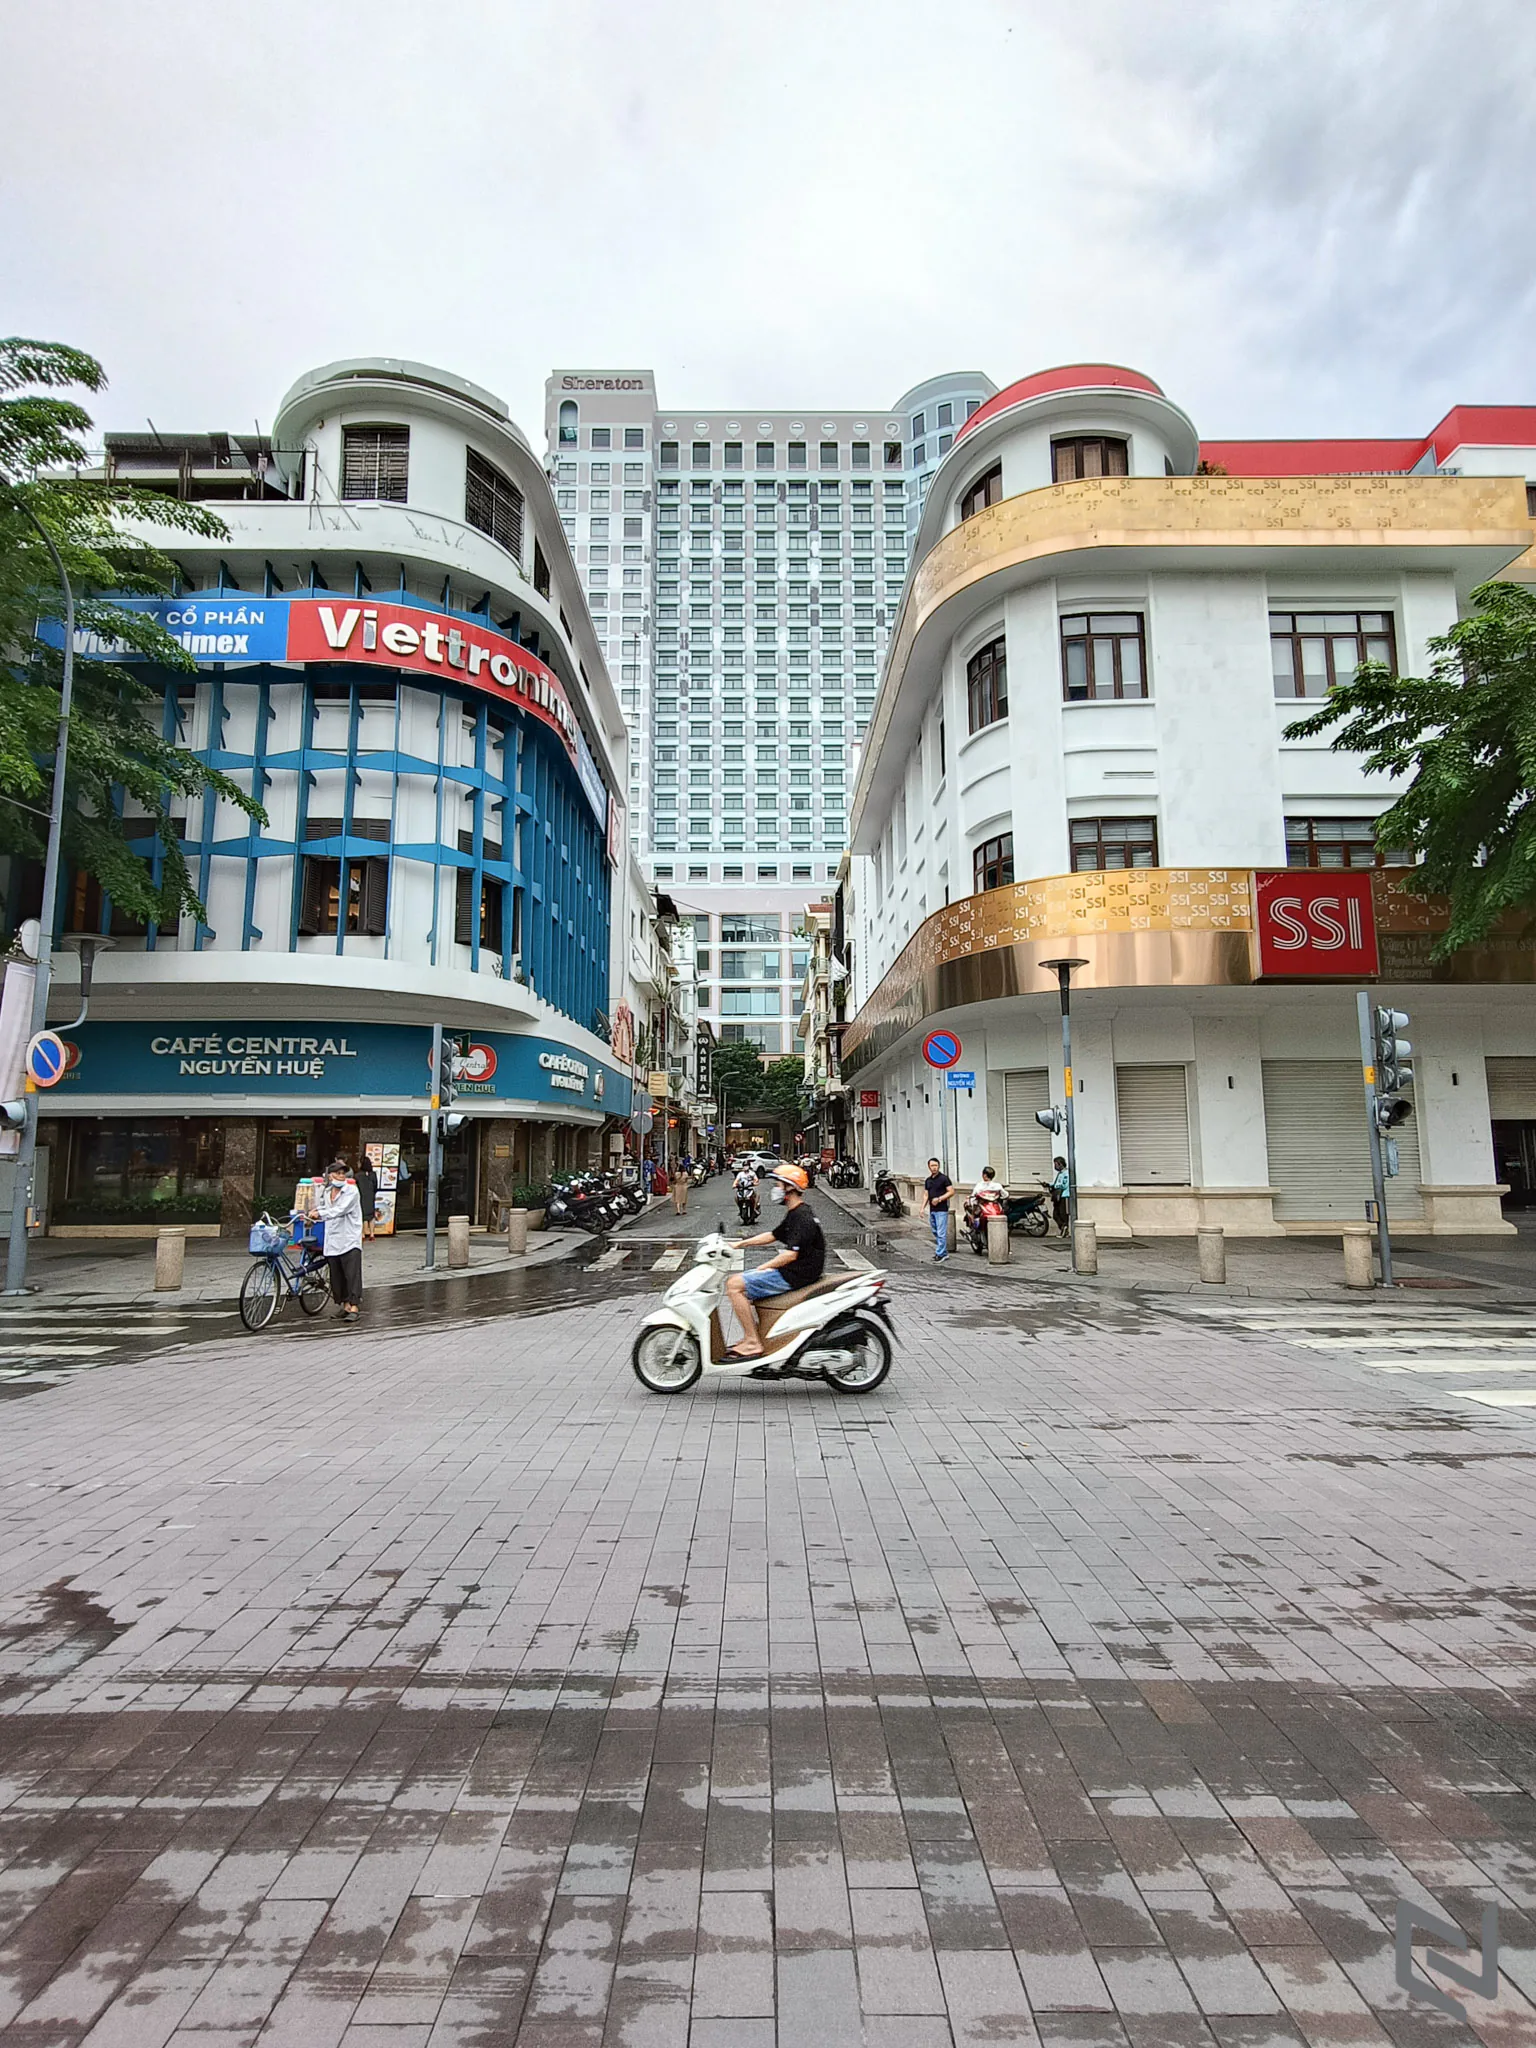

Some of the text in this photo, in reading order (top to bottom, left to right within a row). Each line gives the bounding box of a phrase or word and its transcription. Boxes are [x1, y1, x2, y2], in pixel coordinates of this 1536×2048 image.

[166, 604, 198, 625] CỔ
[204, 606, 264, 625] PHẦN
[1169, 871, 1189, 883] SSI
[1208, 871, 1227, 883] SSI
[1189, 882, 1208, 894] SSI
[1230, 882, 1249, 894] SSI
[1170, 894, 1190, 906] SSI
[1209, 894, 1229, 906] SSI
[1191, 905, 1210, 917] SSI
[1231, 905, 1251, 916] SSI
[1130, 916, 1150, 929] SSI
[1270, 897, 1363, 950] SSI
[1013, 928, 1030, 941] SSI
[983, 934, 997, 948] SSI
[150, 1033, 358, 1056] CAFÉ CENTRAL
[179, 1055, 325, 1079] NGUYỄN HUỆ
[474, 1083, 496, 1095] HUE
[861, 1093, 877, 1104] SSI
